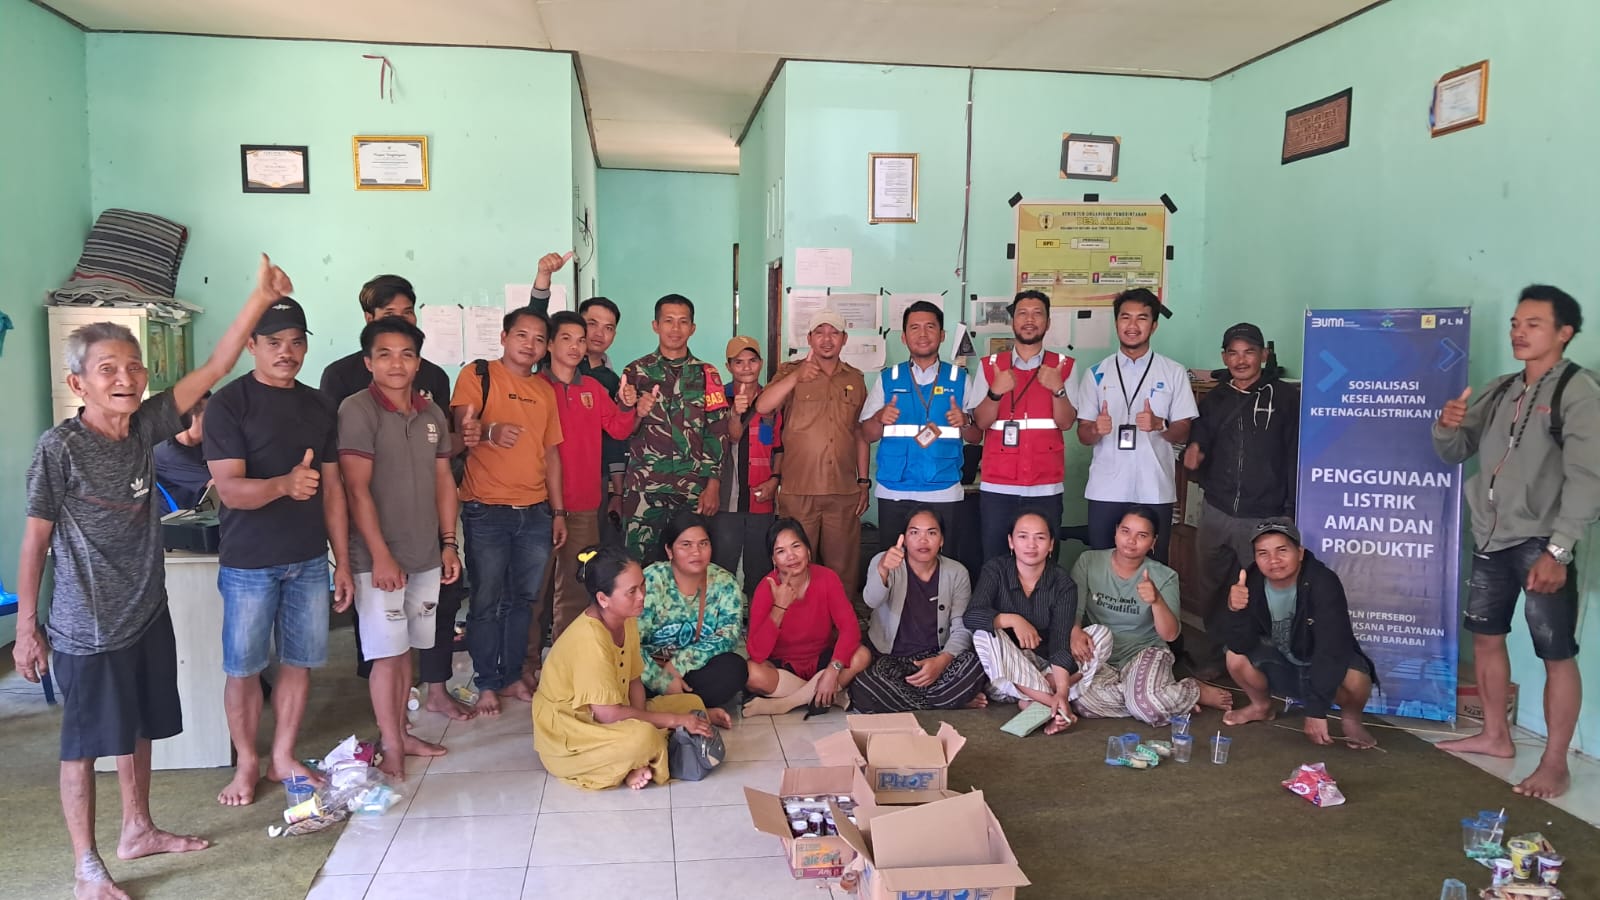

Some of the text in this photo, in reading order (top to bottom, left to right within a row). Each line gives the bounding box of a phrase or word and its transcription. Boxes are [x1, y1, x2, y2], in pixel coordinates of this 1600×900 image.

[1349, 381, 1419, 391] SOSIALISASI
[1341, 394, 1426, 404] KESELAMATAN
[1310, 407, 1432, 419] KETENAGALISTRIKAN
[1311, 468, 1452, 488] PENGGUNAAN
[1343, 492, 1416, 510] LISTRIK
[1324, 515, 1434, 535] AMAN DAN
[1321, 538, 1434, 558] PRODUKTIF
[1366, 611, 1416, 623] (PERSERO)
[1352, 622, 1445, 637] KSANA PELAYANAN
[1382, 636, 1426, 646] BARABAI
